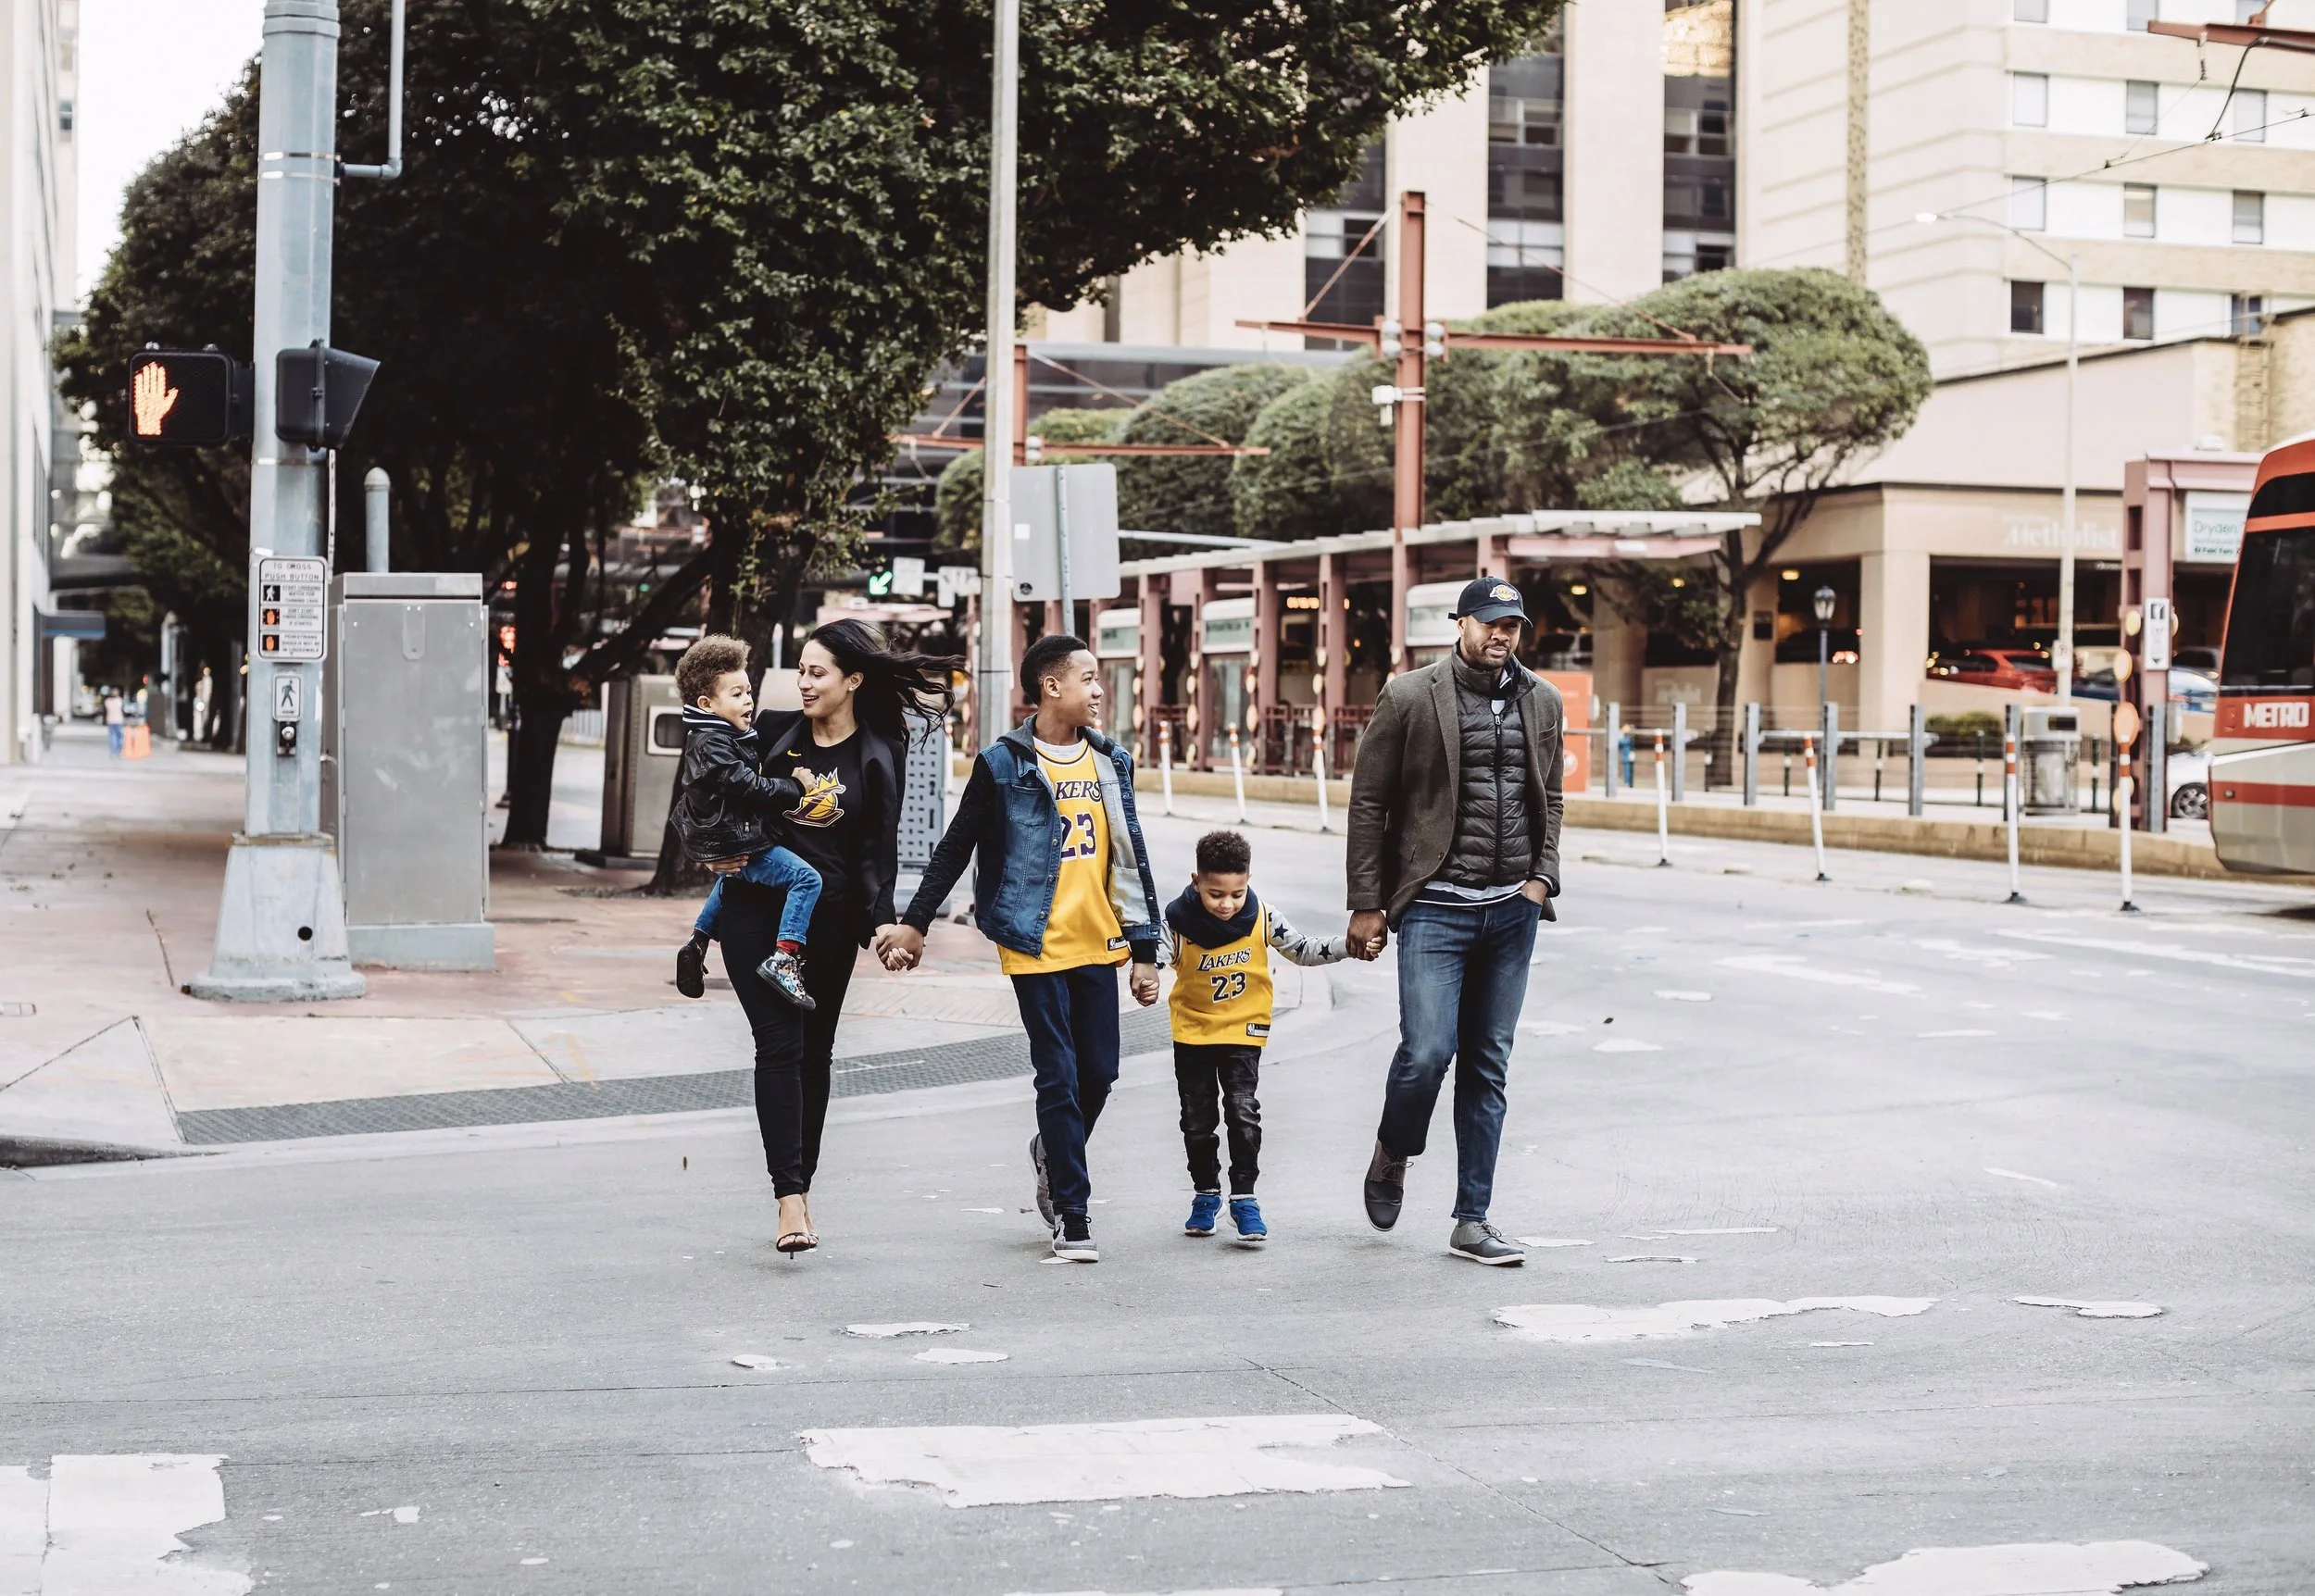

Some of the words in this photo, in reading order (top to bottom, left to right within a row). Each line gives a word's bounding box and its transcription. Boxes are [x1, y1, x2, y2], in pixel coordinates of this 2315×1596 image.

[2003, 521, 2119, 549] Methdist
[2194, 520, 2237, 537] Dryden
[2243, 701, 2309, 729] METRO
[1055, 780, 1102, 803] KERS
[1060, 812, 1096, 861] 23
[1195, 947, 1252, 972] LAKERS
[1211, 970, 1248, 1004] 23
